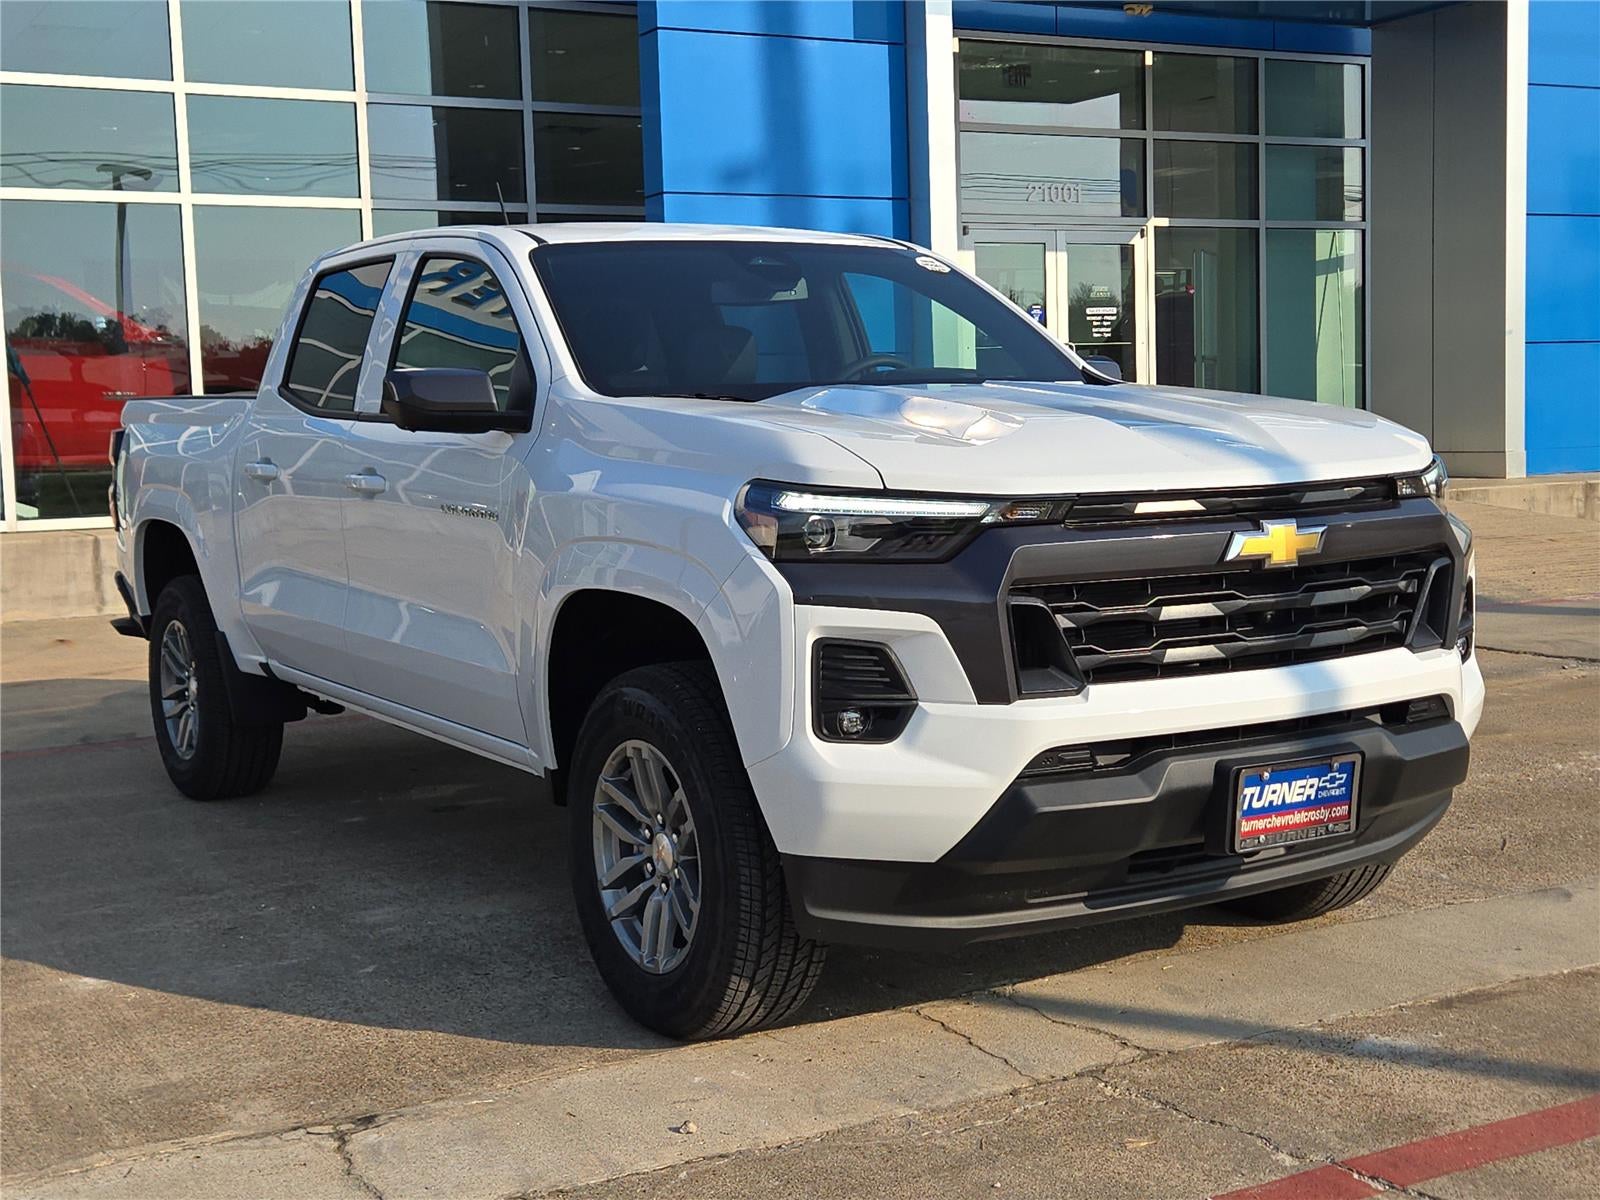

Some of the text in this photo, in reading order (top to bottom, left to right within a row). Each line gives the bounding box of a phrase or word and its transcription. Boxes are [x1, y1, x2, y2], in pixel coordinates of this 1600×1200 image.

[1024, 183, 1080, 204] 21001
[1242, 778, 1319, 810] TURNER
[1241, 805, 1348, 832] turnerchevroletcrosby.com
